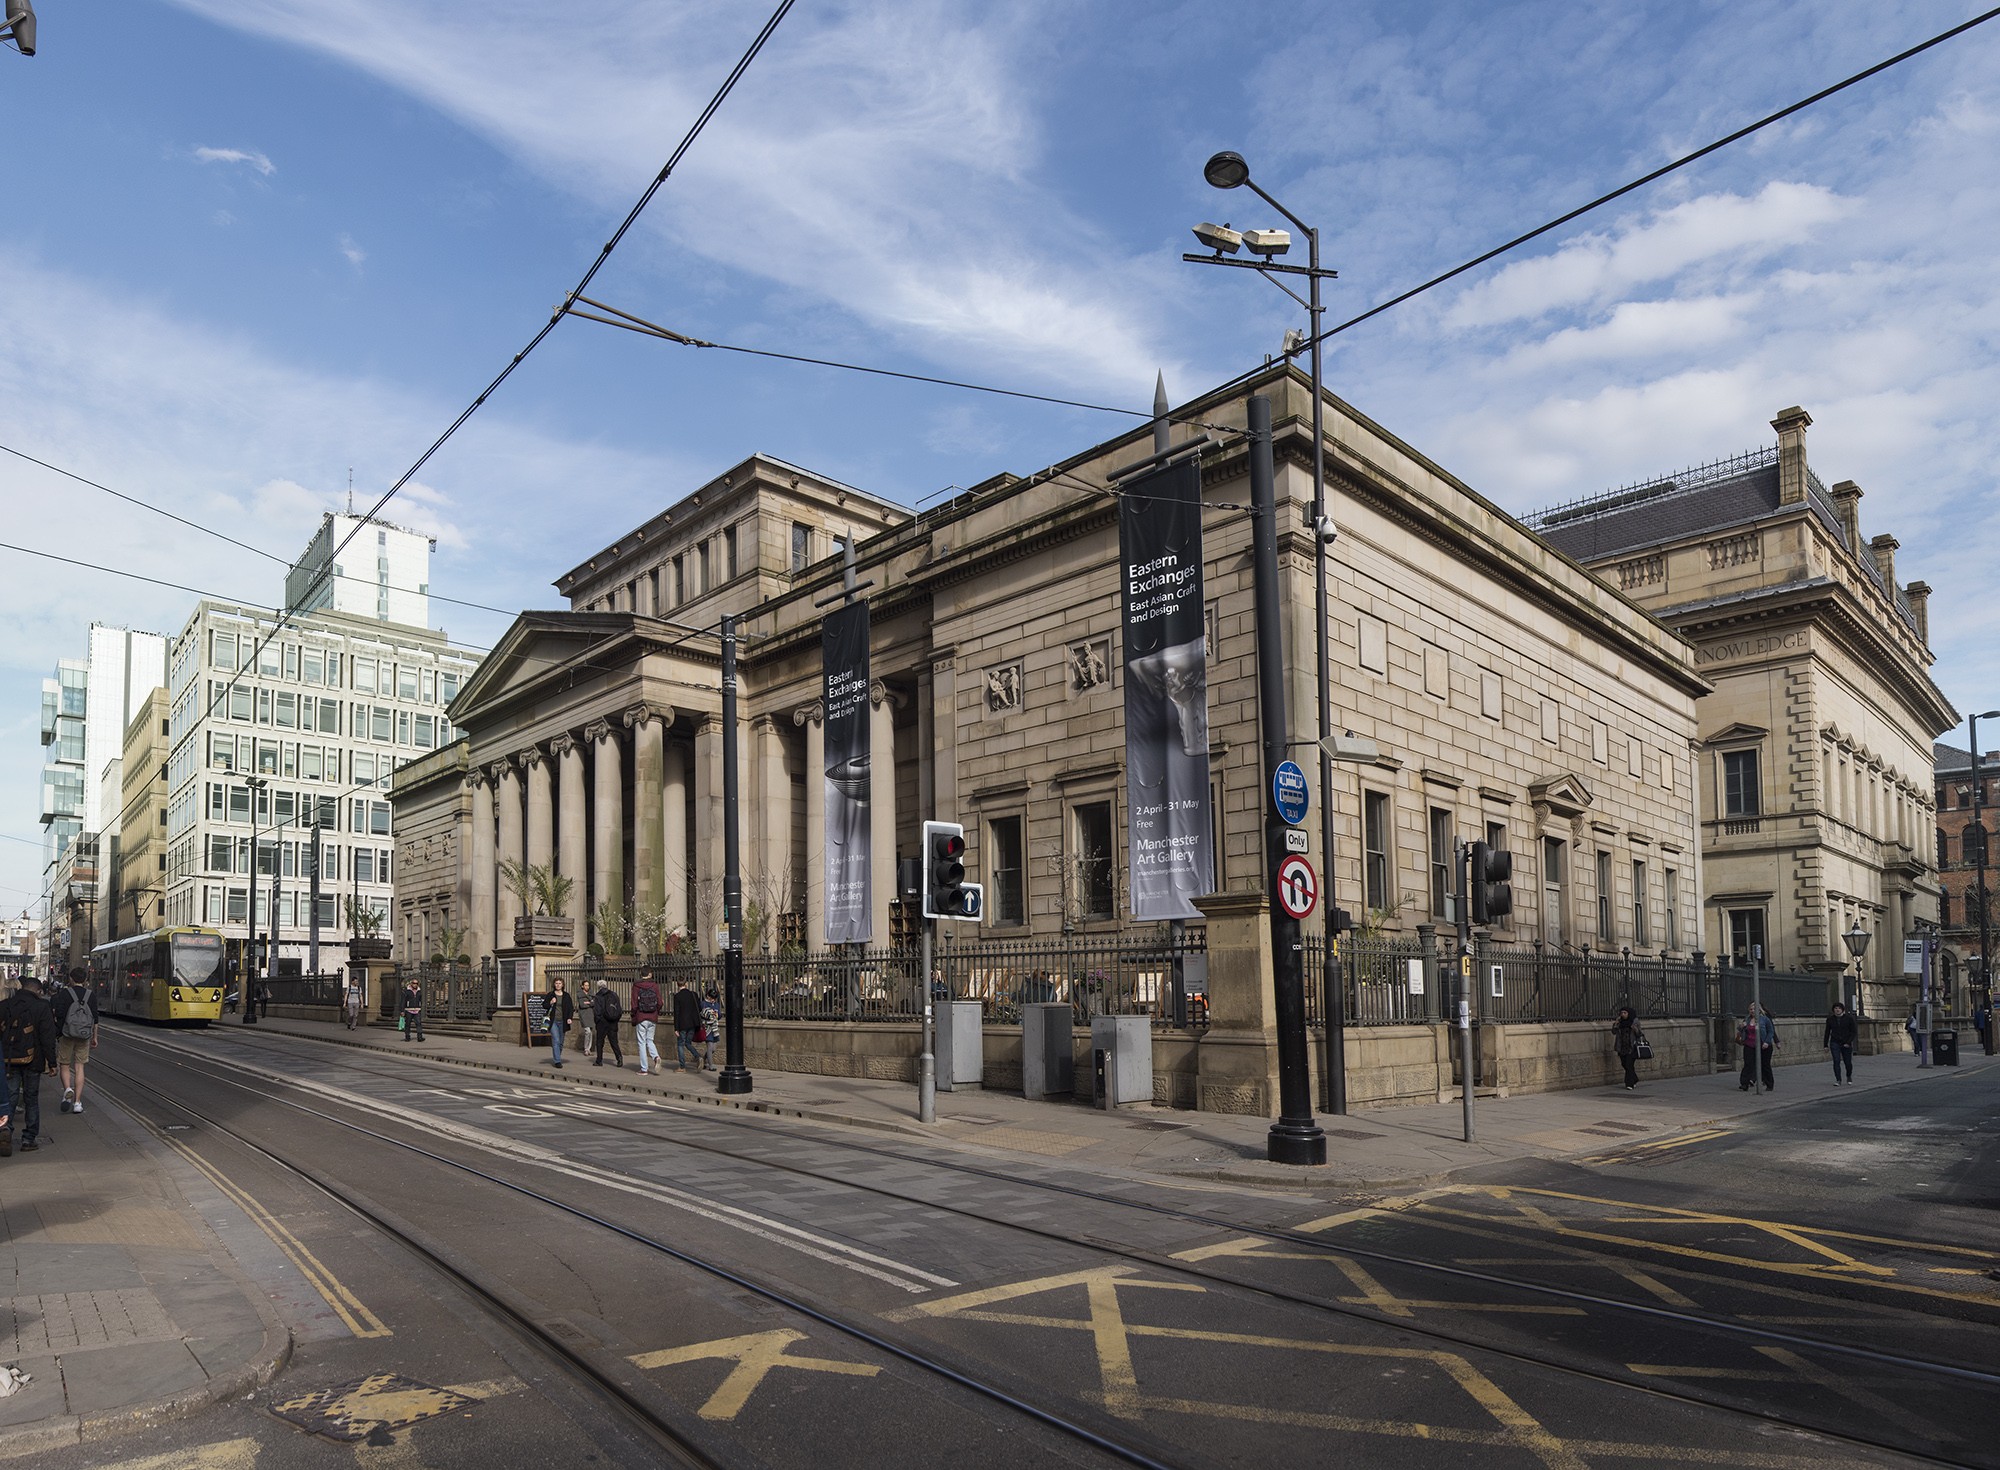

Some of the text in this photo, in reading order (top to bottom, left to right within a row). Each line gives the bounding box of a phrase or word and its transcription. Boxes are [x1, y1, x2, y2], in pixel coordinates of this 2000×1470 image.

[1129, 555, 1177, 578] Eastern
[1130, 564, 1195, 595] Exchanges
[1130, 583, 1196, 612] East Asian Craft
[1130, 604, 1179, 624] and Design
[828, 669, 853, 686] Eastern
[828, 678, 867, 699] Exchanges
[828, 702, 841, 711] East
[852, 693, 867, 703] Craft
[828, 710, 840, 720] and
[1136, 806, 1142, 815] 2
[1182, 799, 1199, 810] May
[1286, 808, 1299, 819] TAXI
[1136, 819, 1154, 829] Free
[1137, 834, 1199, 851] Manchester
[1288, 834, 1306, 848] Only
[1137, 848, 1195, 865] Art Gallery
[407, 1087, 626, 1100] TRAM
[482, 1100, 691, 1118] ONLY
